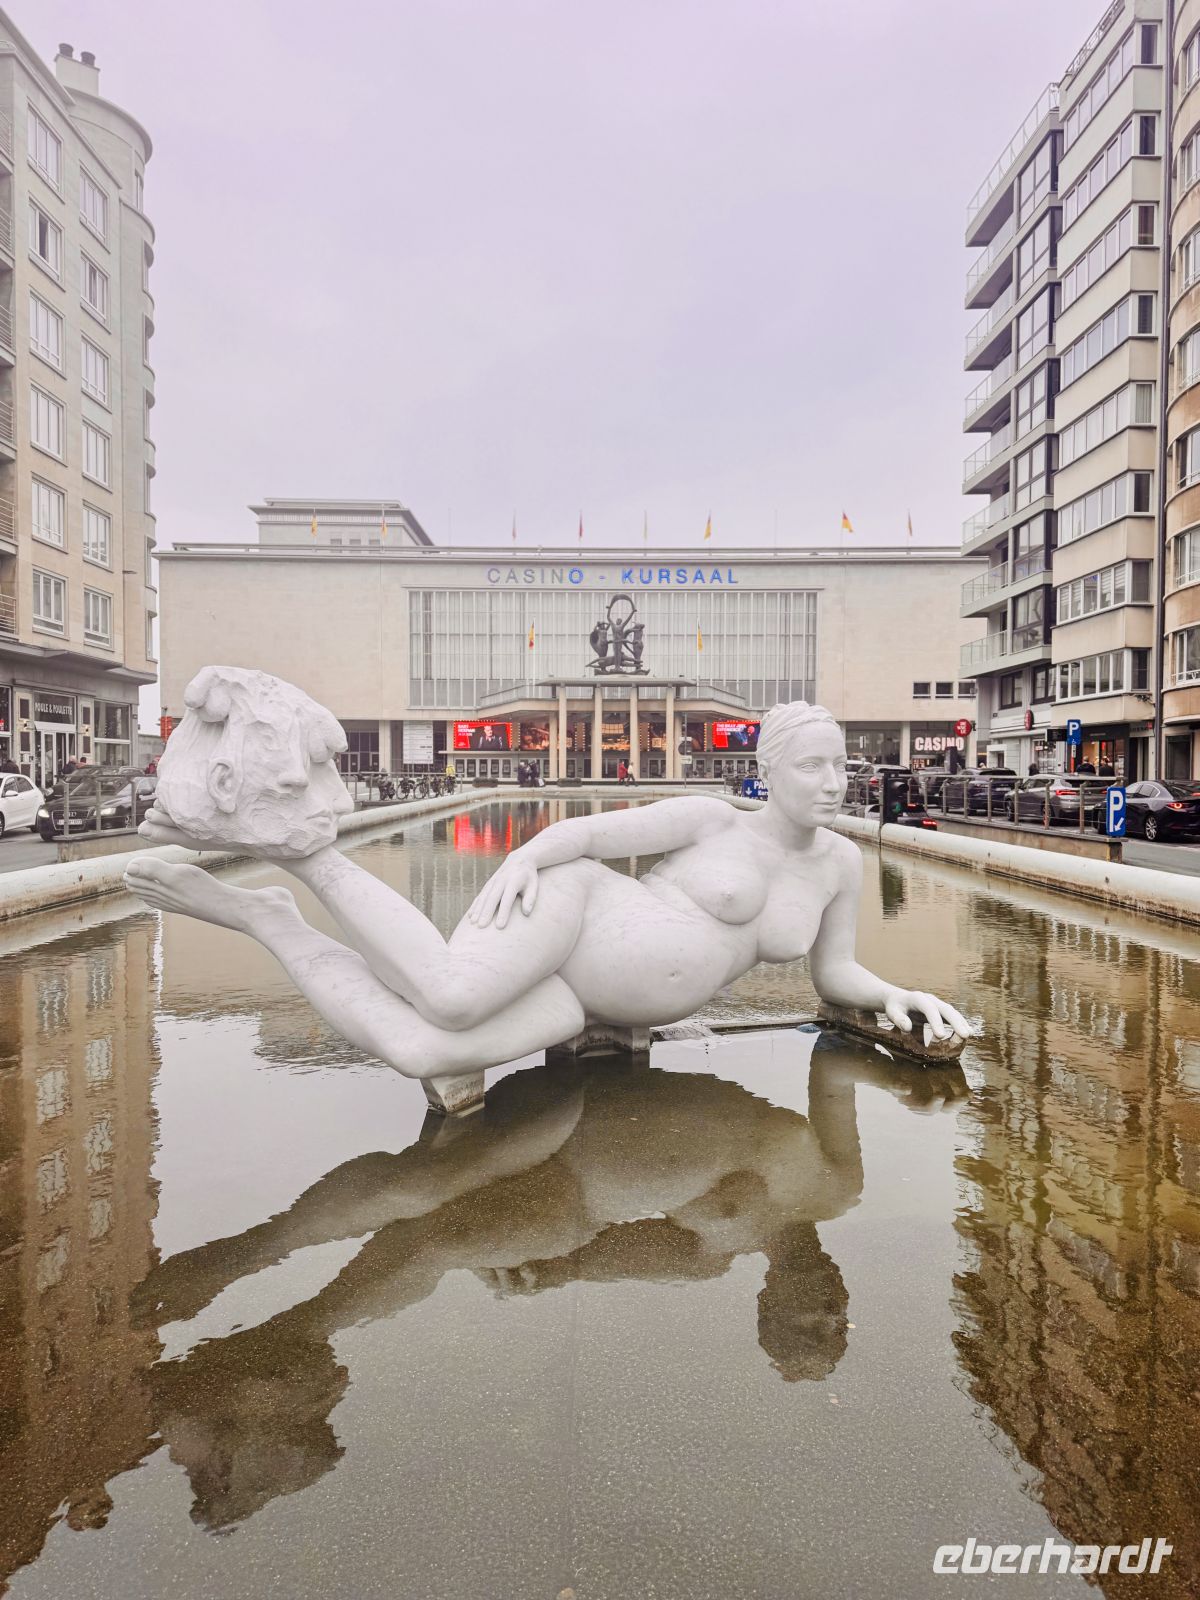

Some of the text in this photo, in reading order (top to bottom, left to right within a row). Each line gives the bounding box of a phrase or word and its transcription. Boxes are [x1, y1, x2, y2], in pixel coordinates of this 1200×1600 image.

[487, 567, 584, 585] CASINO
[621, 567, 739, 585] KURSAAL
[34, 702, 49, 713] POULE
[53, 704, 73, 716] POULETTE
[1069, 722, 1079, 736] P
[915, 736, 965, 751] CASINO
[1109, 790, 1124, 833] P
